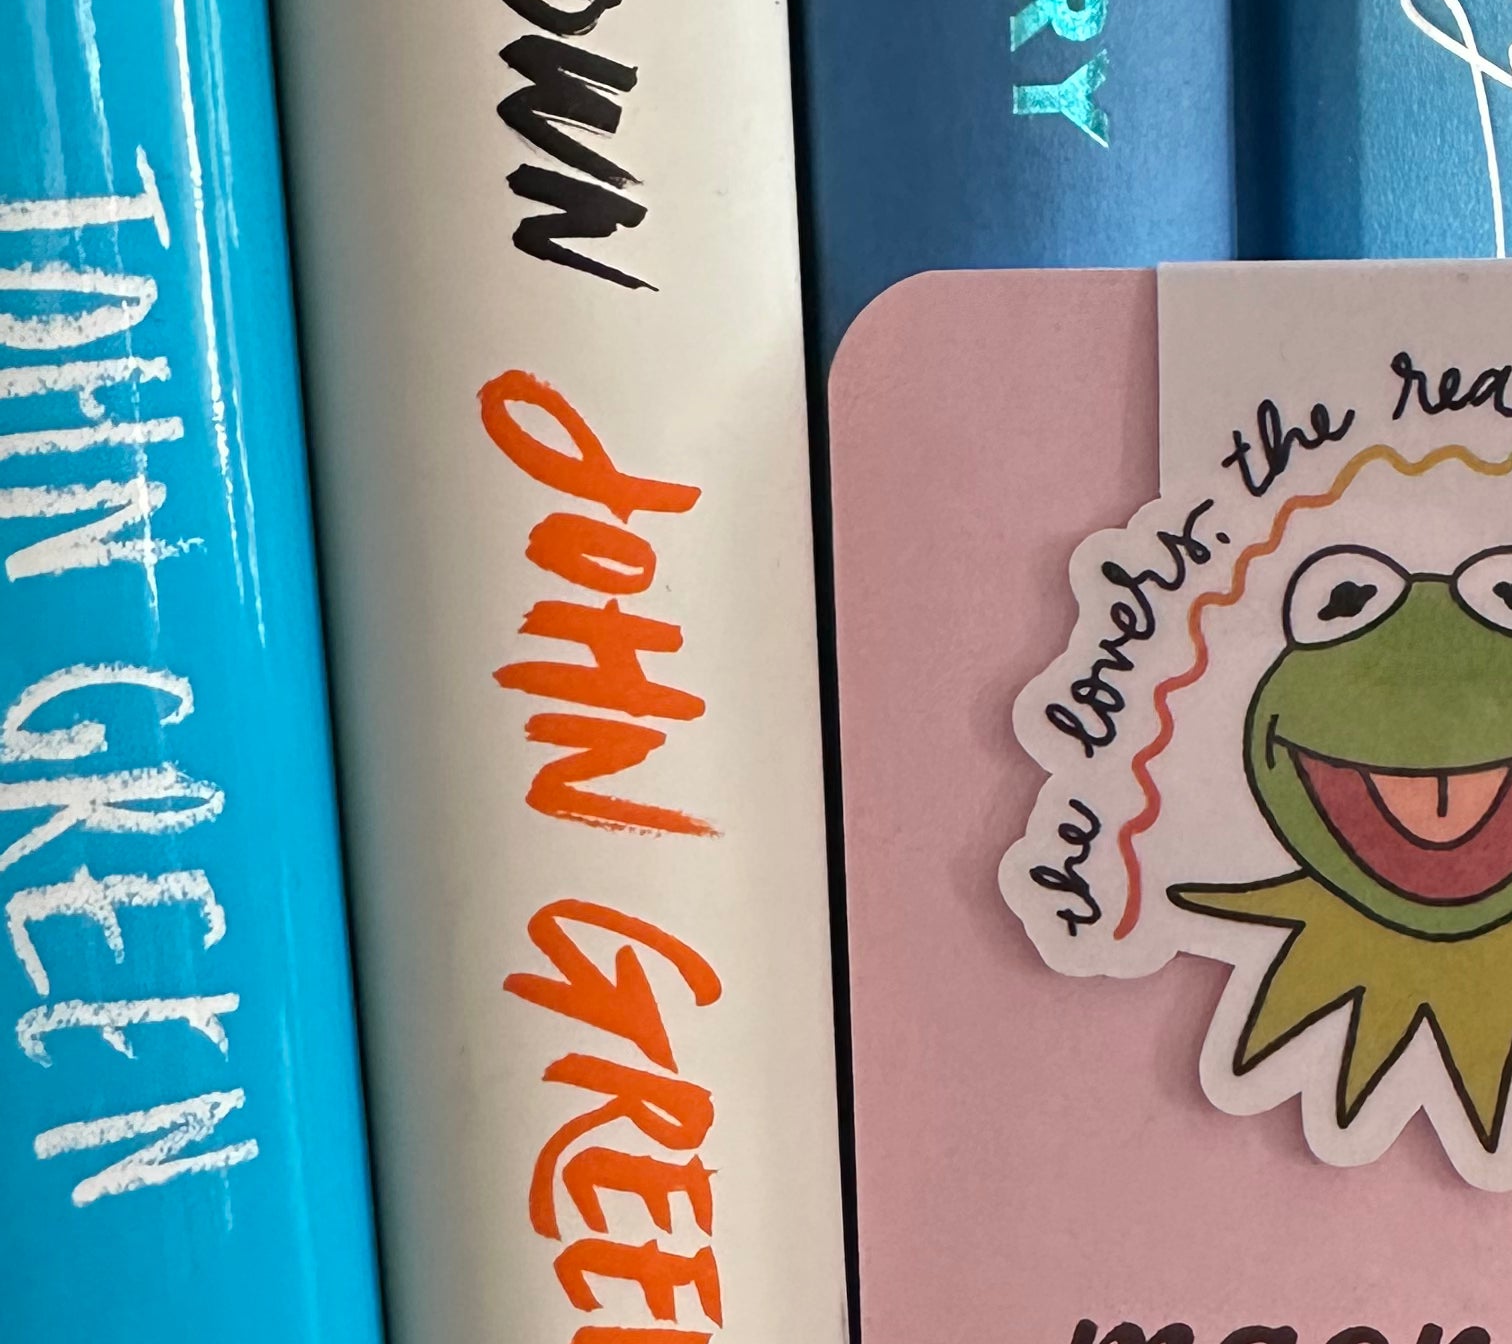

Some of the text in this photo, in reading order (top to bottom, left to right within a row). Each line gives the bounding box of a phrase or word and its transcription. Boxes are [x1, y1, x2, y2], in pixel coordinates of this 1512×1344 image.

[480, 370, 712, 835] JOHN
[1029, 799, 1101, 936] the
[1222, 399, 1355, 497] the
[0, 664, 258, 1205] GREEN
